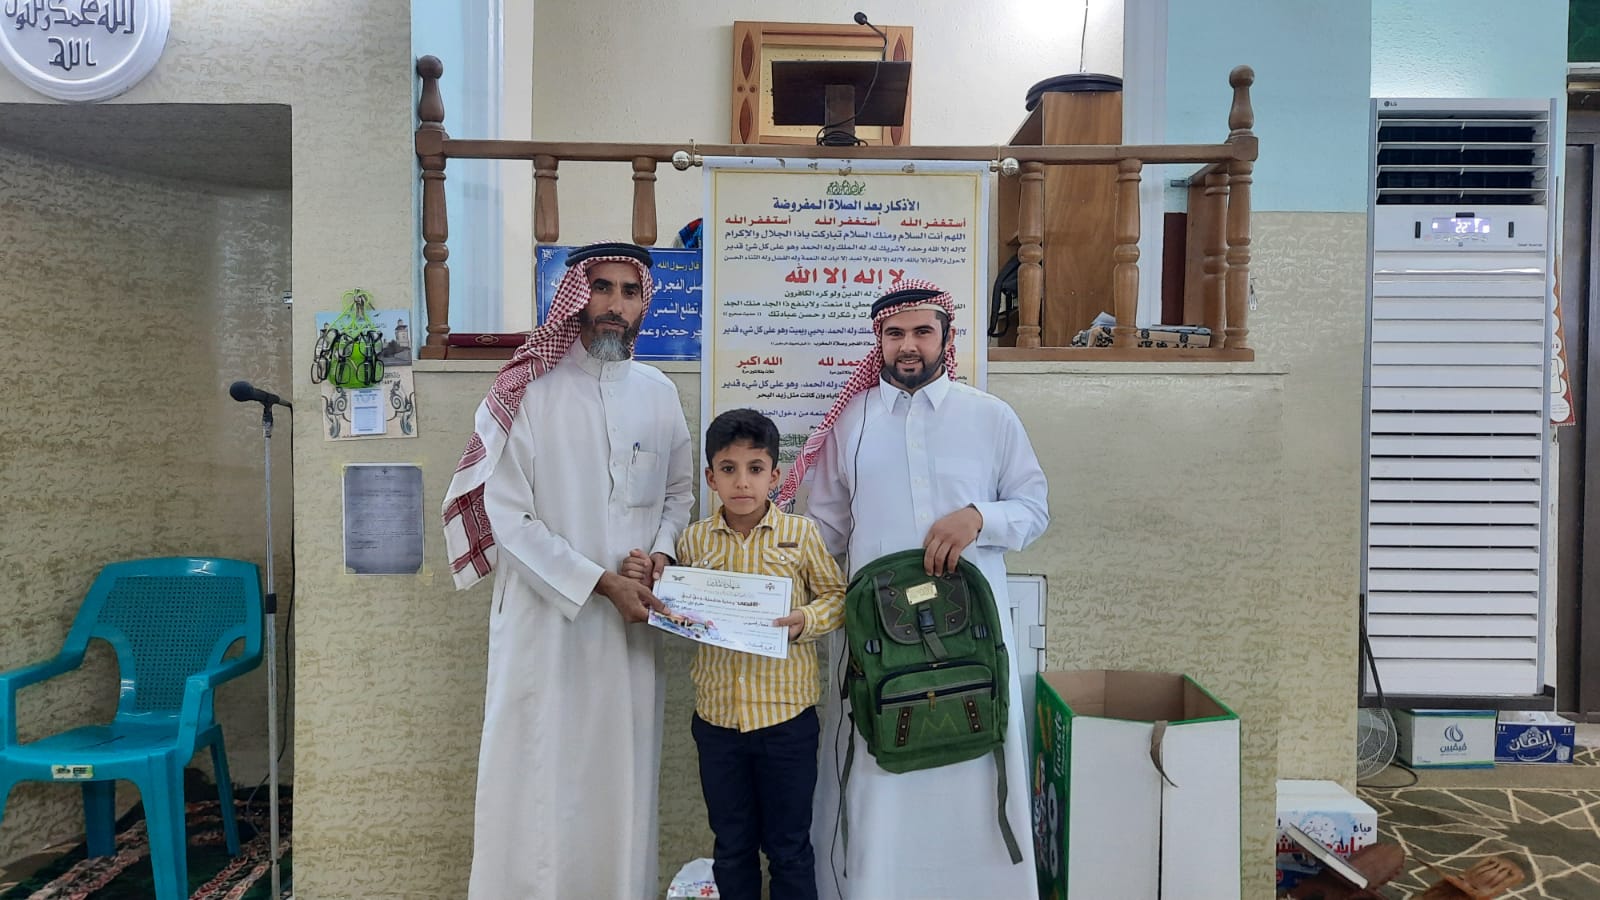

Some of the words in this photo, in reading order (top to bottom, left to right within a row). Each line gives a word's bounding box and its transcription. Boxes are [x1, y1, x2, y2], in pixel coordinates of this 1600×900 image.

[773, 197, 826, 212] المفروضة
[829, 199, 861, 210] الصلاة
[864, 201, 883, 215] بعد
[725, 214, 747, 224] الله
[814, 215, 836, 225] الله
[900, 217, 922, 227] الله
[761, 230, 792, 239] الجلال
[843, 230, 872, 241] السلام
[873, 231, 897, 241] ومنك
[898, 231, 927, 241] السلام
[944, 232, 966, 242] اللهم
[784, 263, 818, 284] الله
[823, 266, 847, 289] إلا
[853, 267, 883, 290] إله
[663, 279, 685, 293] الفجر
[784, 290, 815, 298] الكافرون
[653, 302, 680, 317] الشمس
[763, 356, 783, 366] الله
[818, 356, 834, 366] لله
